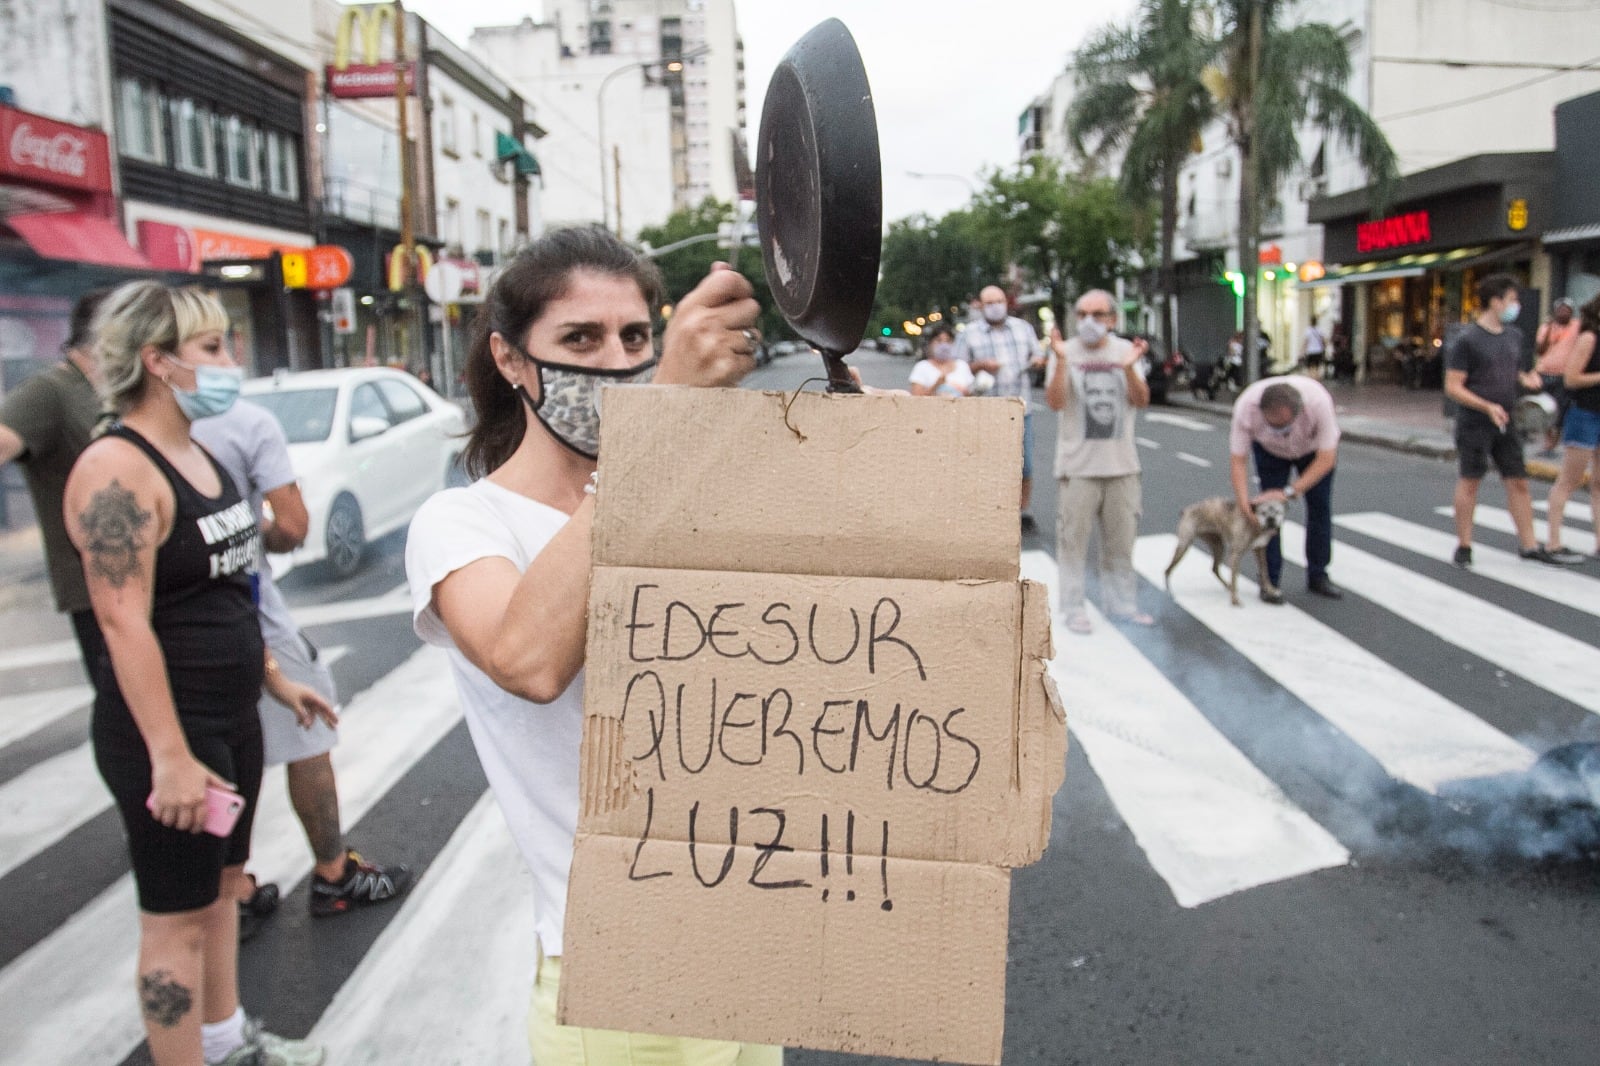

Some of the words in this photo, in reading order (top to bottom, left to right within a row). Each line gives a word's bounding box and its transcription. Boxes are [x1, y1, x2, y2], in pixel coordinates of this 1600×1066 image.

[625, 583, 928, 682] EDESUR
[620, 670, 982, 795] QUEREMOS
[628, 787, 894, 912] LUZ!!!
